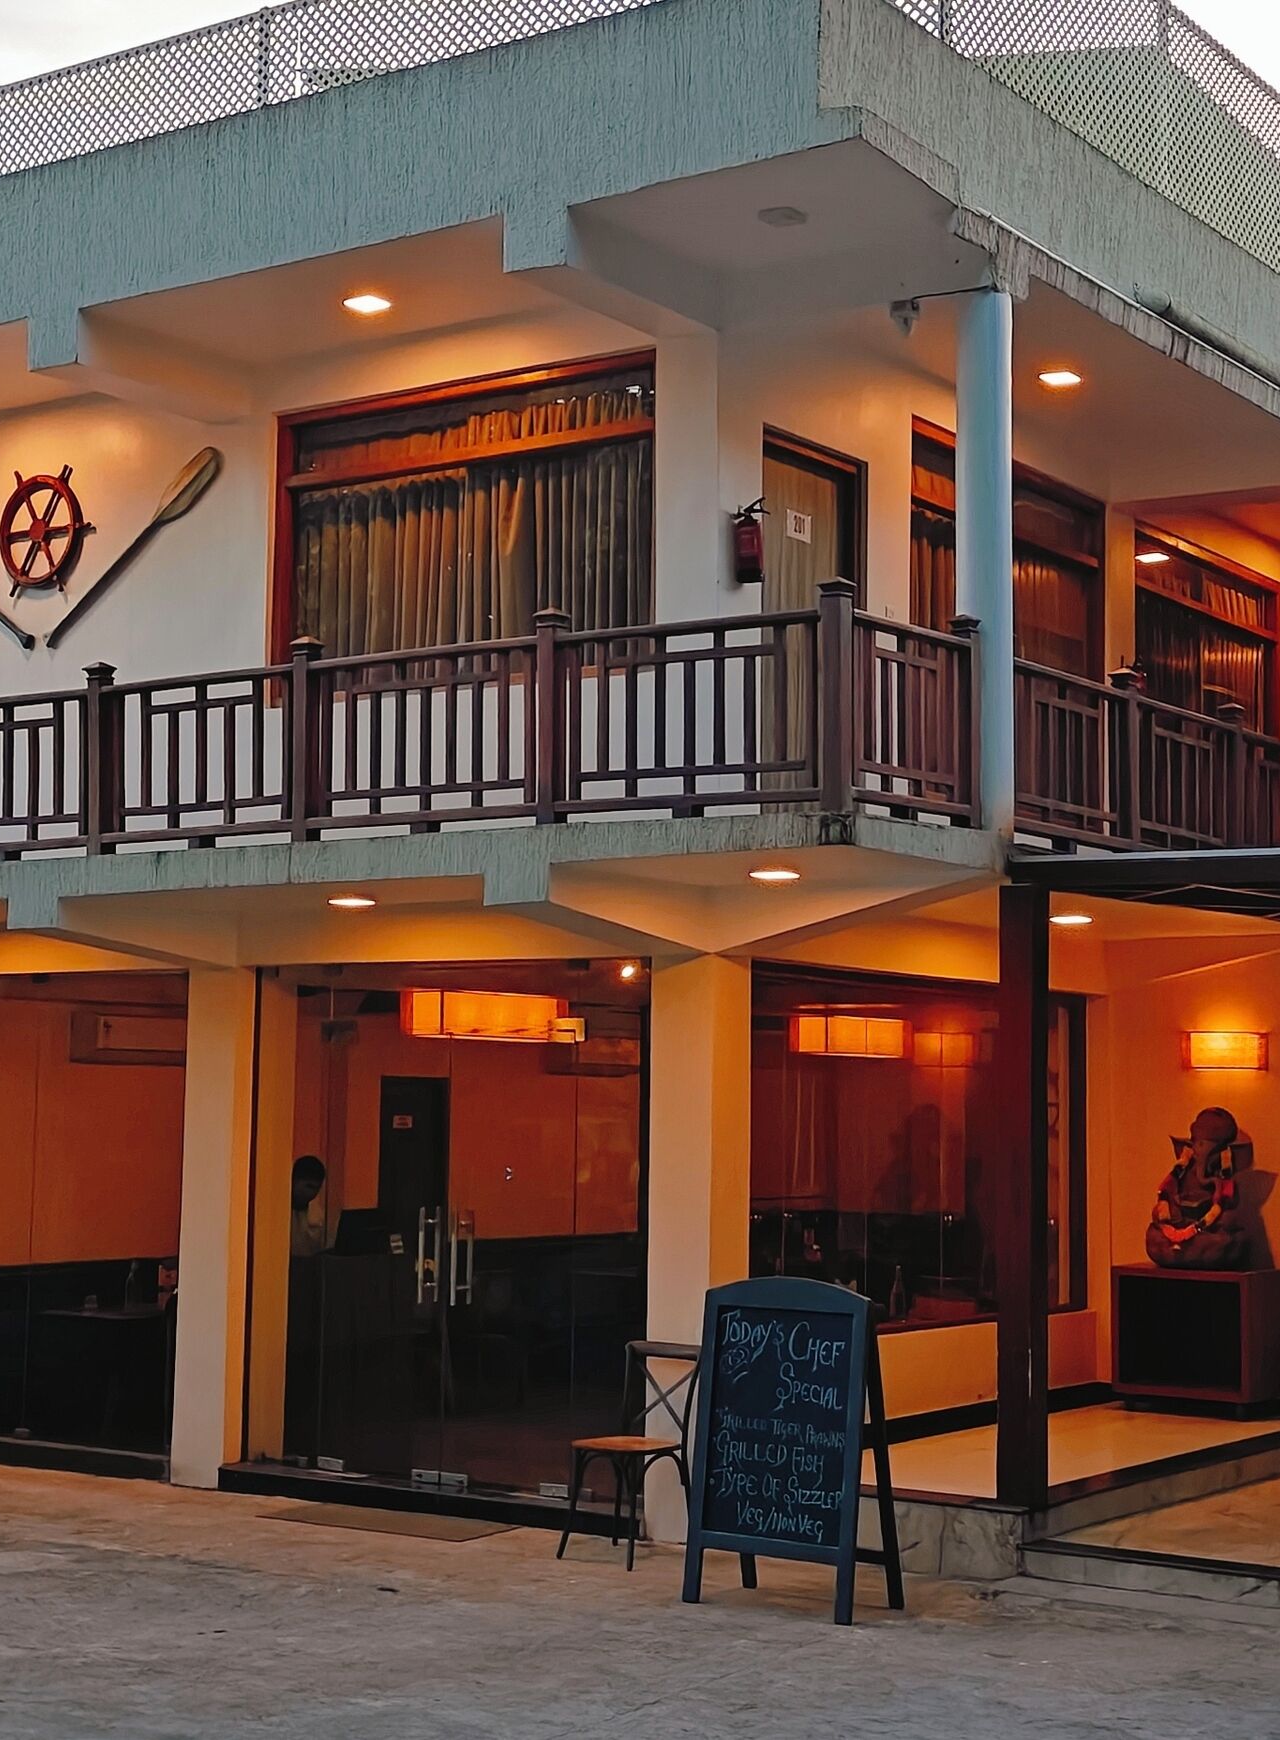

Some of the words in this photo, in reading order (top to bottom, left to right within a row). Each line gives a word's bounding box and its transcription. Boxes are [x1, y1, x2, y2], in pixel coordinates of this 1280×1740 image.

[788, 1321, 846, 1372] CHEF
[773, 1361, 842, 1411] SPECIAL
[770, 1418, 803, 1442] TIGER
[712, 1466, 758, 1498] TYPE
[762, 1472, 783, 1501] OF
[792, 1446, 825, 1489] FISH
